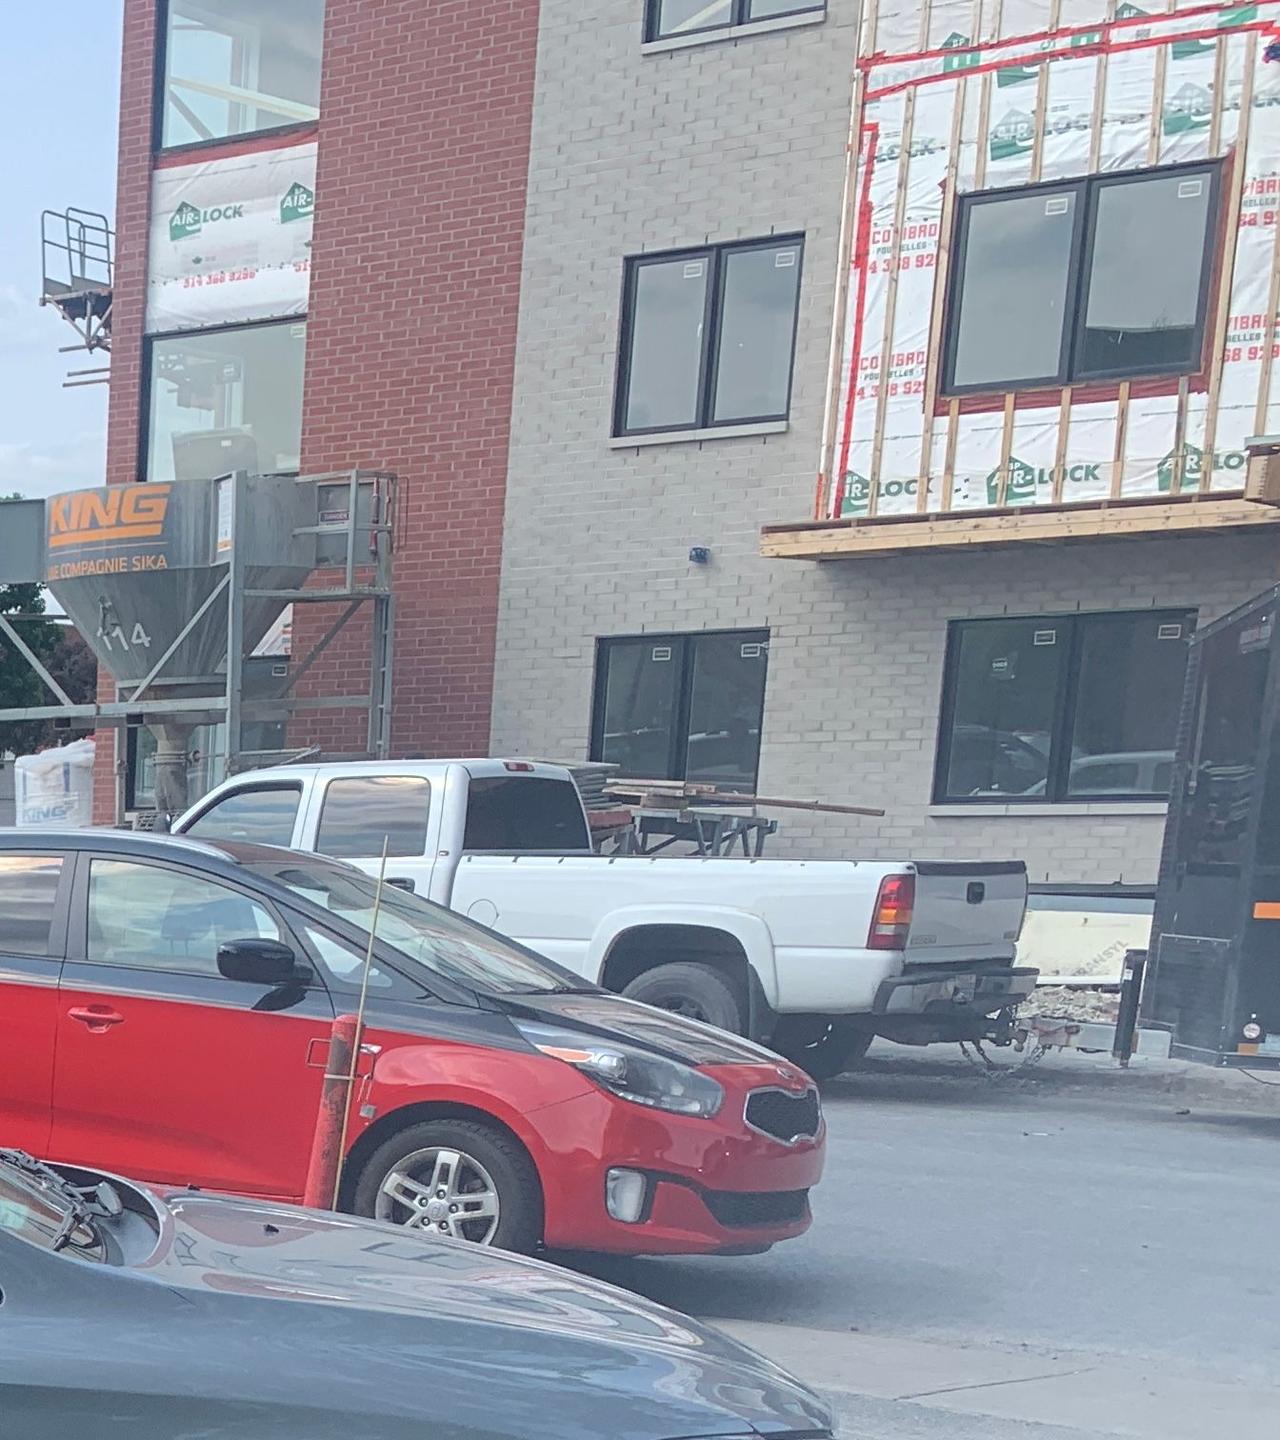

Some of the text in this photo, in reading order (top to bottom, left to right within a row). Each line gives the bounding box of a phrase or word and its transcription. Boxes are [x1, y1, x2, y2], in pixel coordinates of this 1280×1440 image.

[171, 204, 244, 227] AIR-LOCK
[882, 256, 911, 273] 38
[915, 253, 934, 268] 92
[870, 383, 898, 398] 38
[903, 380, 922, 395] 92
[49, 484, 172, 534] KING
[60, 557, 128, 579] COMPAGNIE
[132, 554, 168, 571] SIKA
[96, 622, 151, 651] 114
